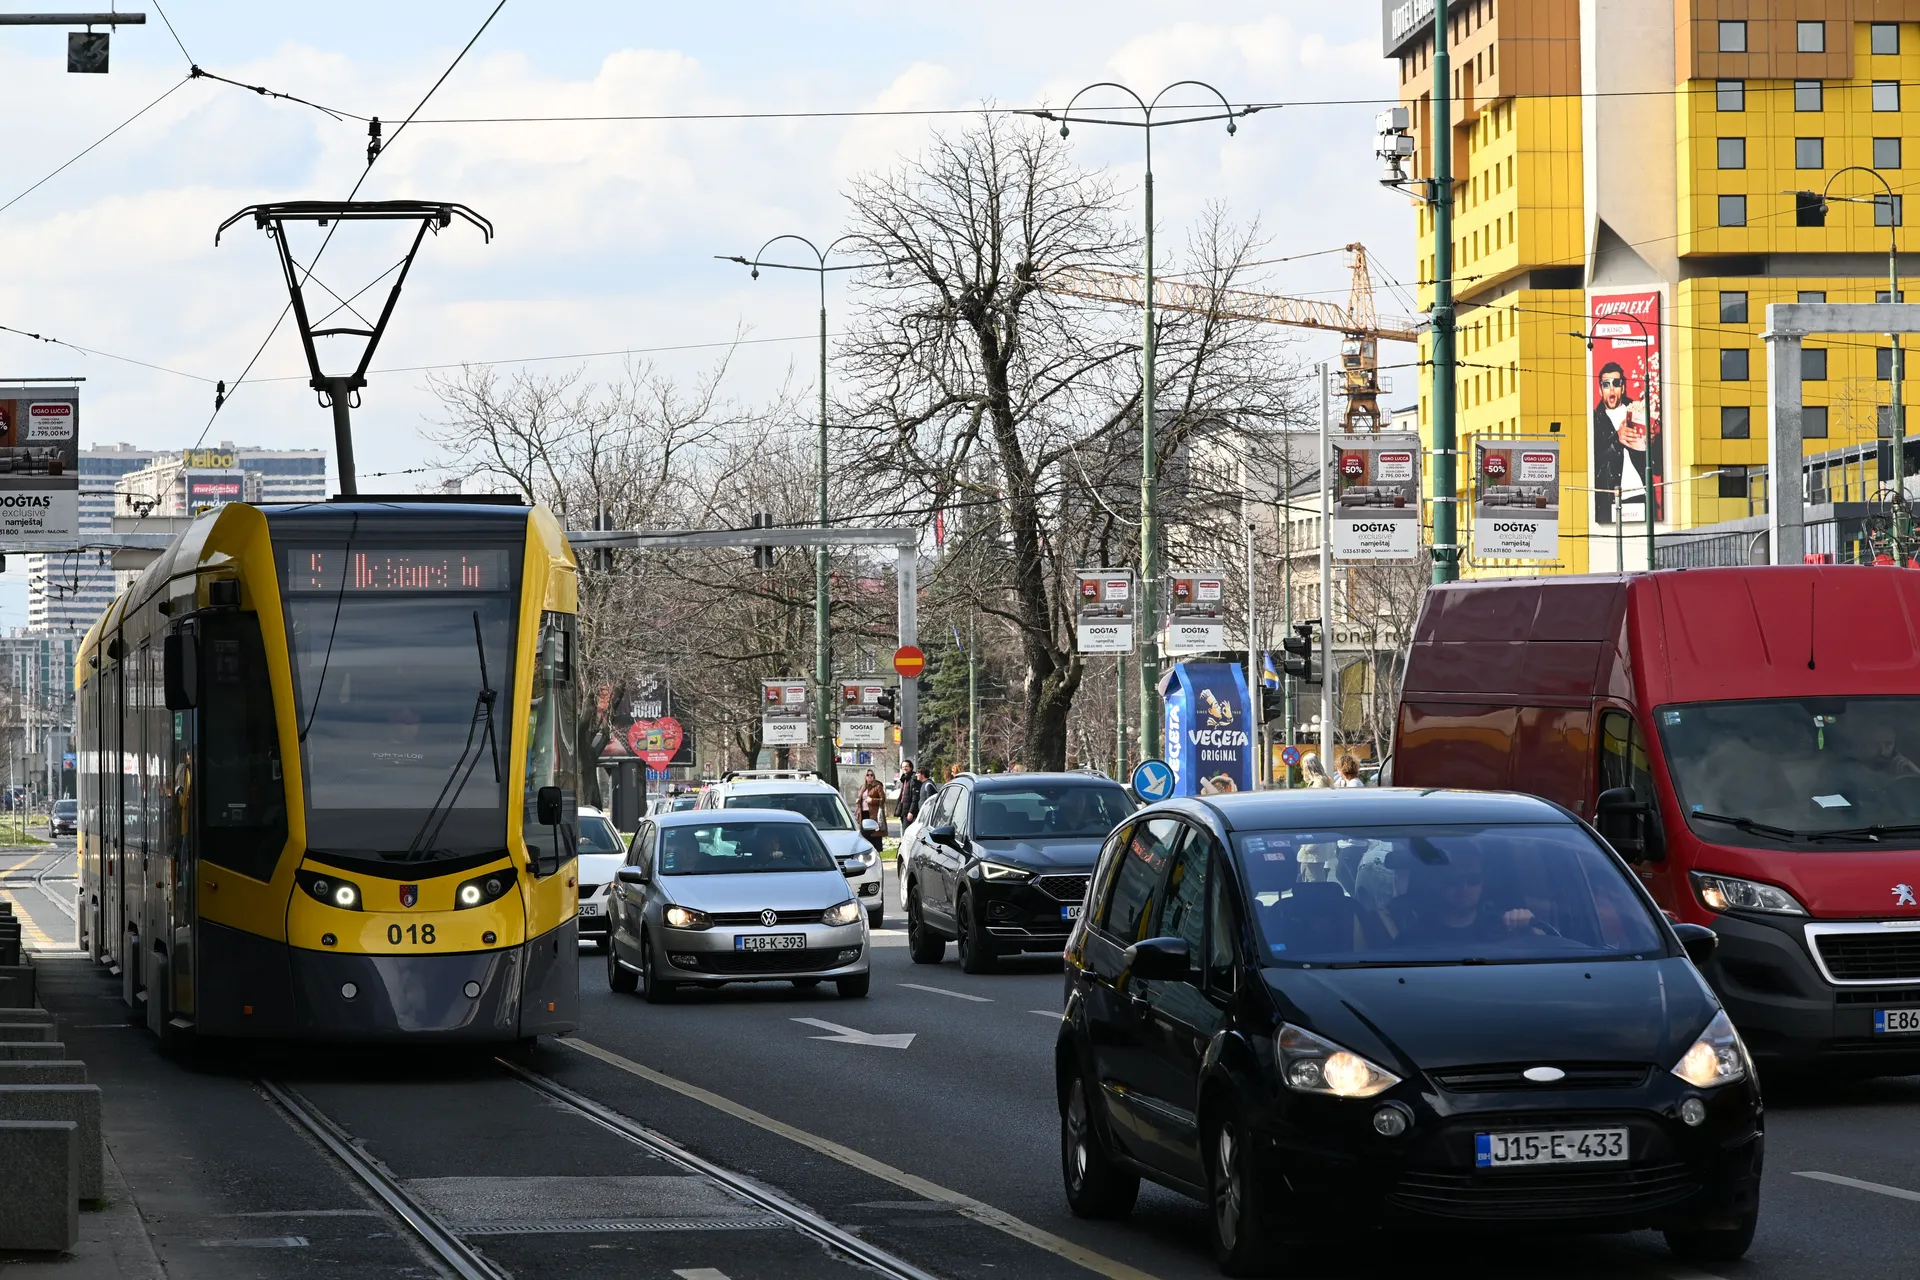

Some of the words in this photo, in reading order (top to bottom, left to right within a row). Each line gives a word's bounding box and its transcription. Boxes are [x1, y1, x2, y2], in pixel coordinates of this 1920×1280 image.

[1594, 296, 1655, 316] CINEPLEXX
[31, 430, 59, 438] 2.795,00
[1341, 465, 1363, 474] -50%
[1484, 465, 1506, 473] -50%
[2, 508, 46, 518] exclusive
[5, 518, 43, 528] namještaj
[1189, 730, 1249, 748] VEGETA
[1201, 749, 1237, 761] ORIGINAL
[387, 923, 436, 945] 018
[743, 936, 804, 949] E18-K-393
[1887, 1011, 1920, 1030] E86
[1494, 1132, 1623, 1162] J15-E-433
